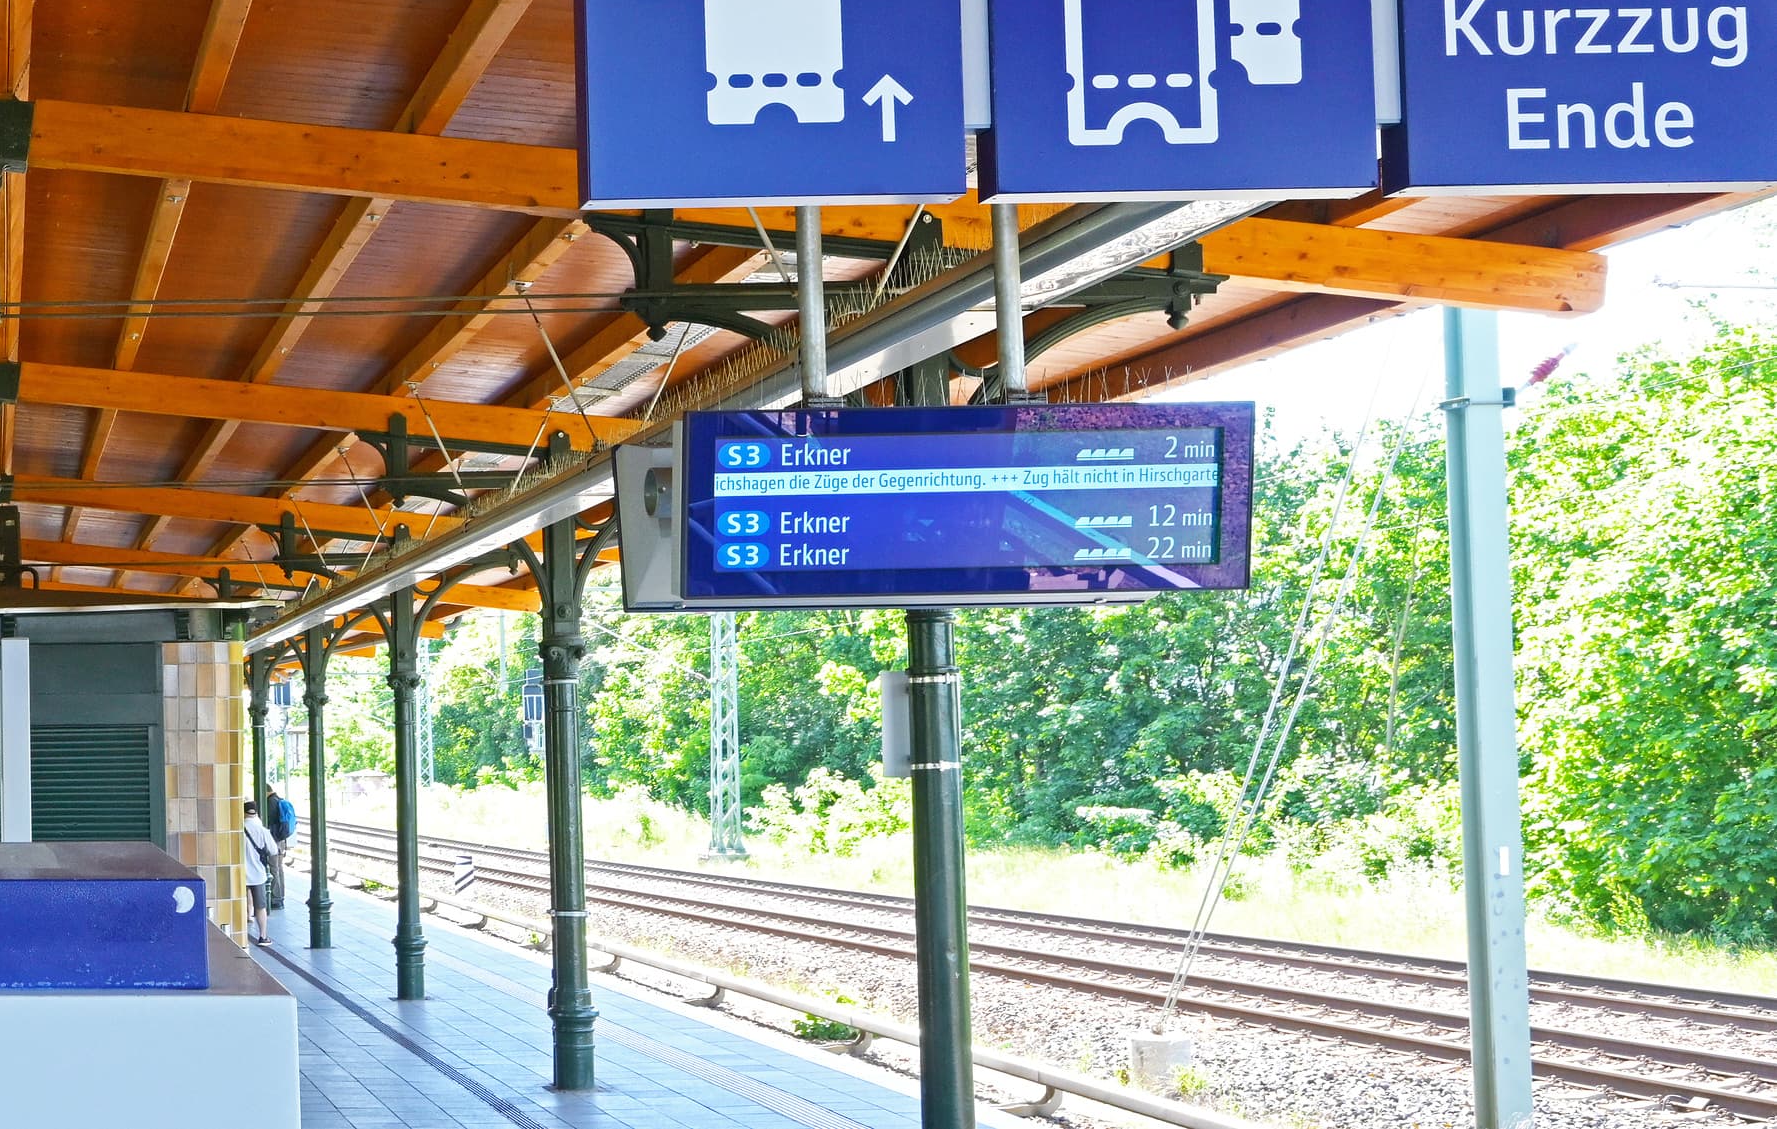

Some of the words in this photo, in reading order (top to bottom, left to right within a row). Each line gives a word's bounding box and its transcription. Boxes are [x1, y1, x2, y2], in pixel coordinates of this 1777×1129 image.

[1506, 82, 1694, 149] Ende
[781, 443, 851, 466] Erkner
[1164, 436, 1178, 458] 2
[1184, 441, 1215, 458] min
[715, 476, 785, 493] ichshagen
[789, 475, 810, 490] die
[814, 474, 848, 492] Züge
[852, 473, 875, 488] der
[878, 472, 986, 490] Gegenrichtung.
[1023, 470, 1048, 487] Zug
[1053, 469, 1079, 485] hält
[1084, 468, 1119, 484] nicht
[1122, 468, 1135, 482] in
[780, 511, 850, 534] Erkner
[1149, 504, 1176, 527] 12
[1182, 508, 1212, 526] min
[780, 543, 850, 566] Erkner
[1146, 536, 1175, 559] 22
[1181, 541, 1211, 558] min
